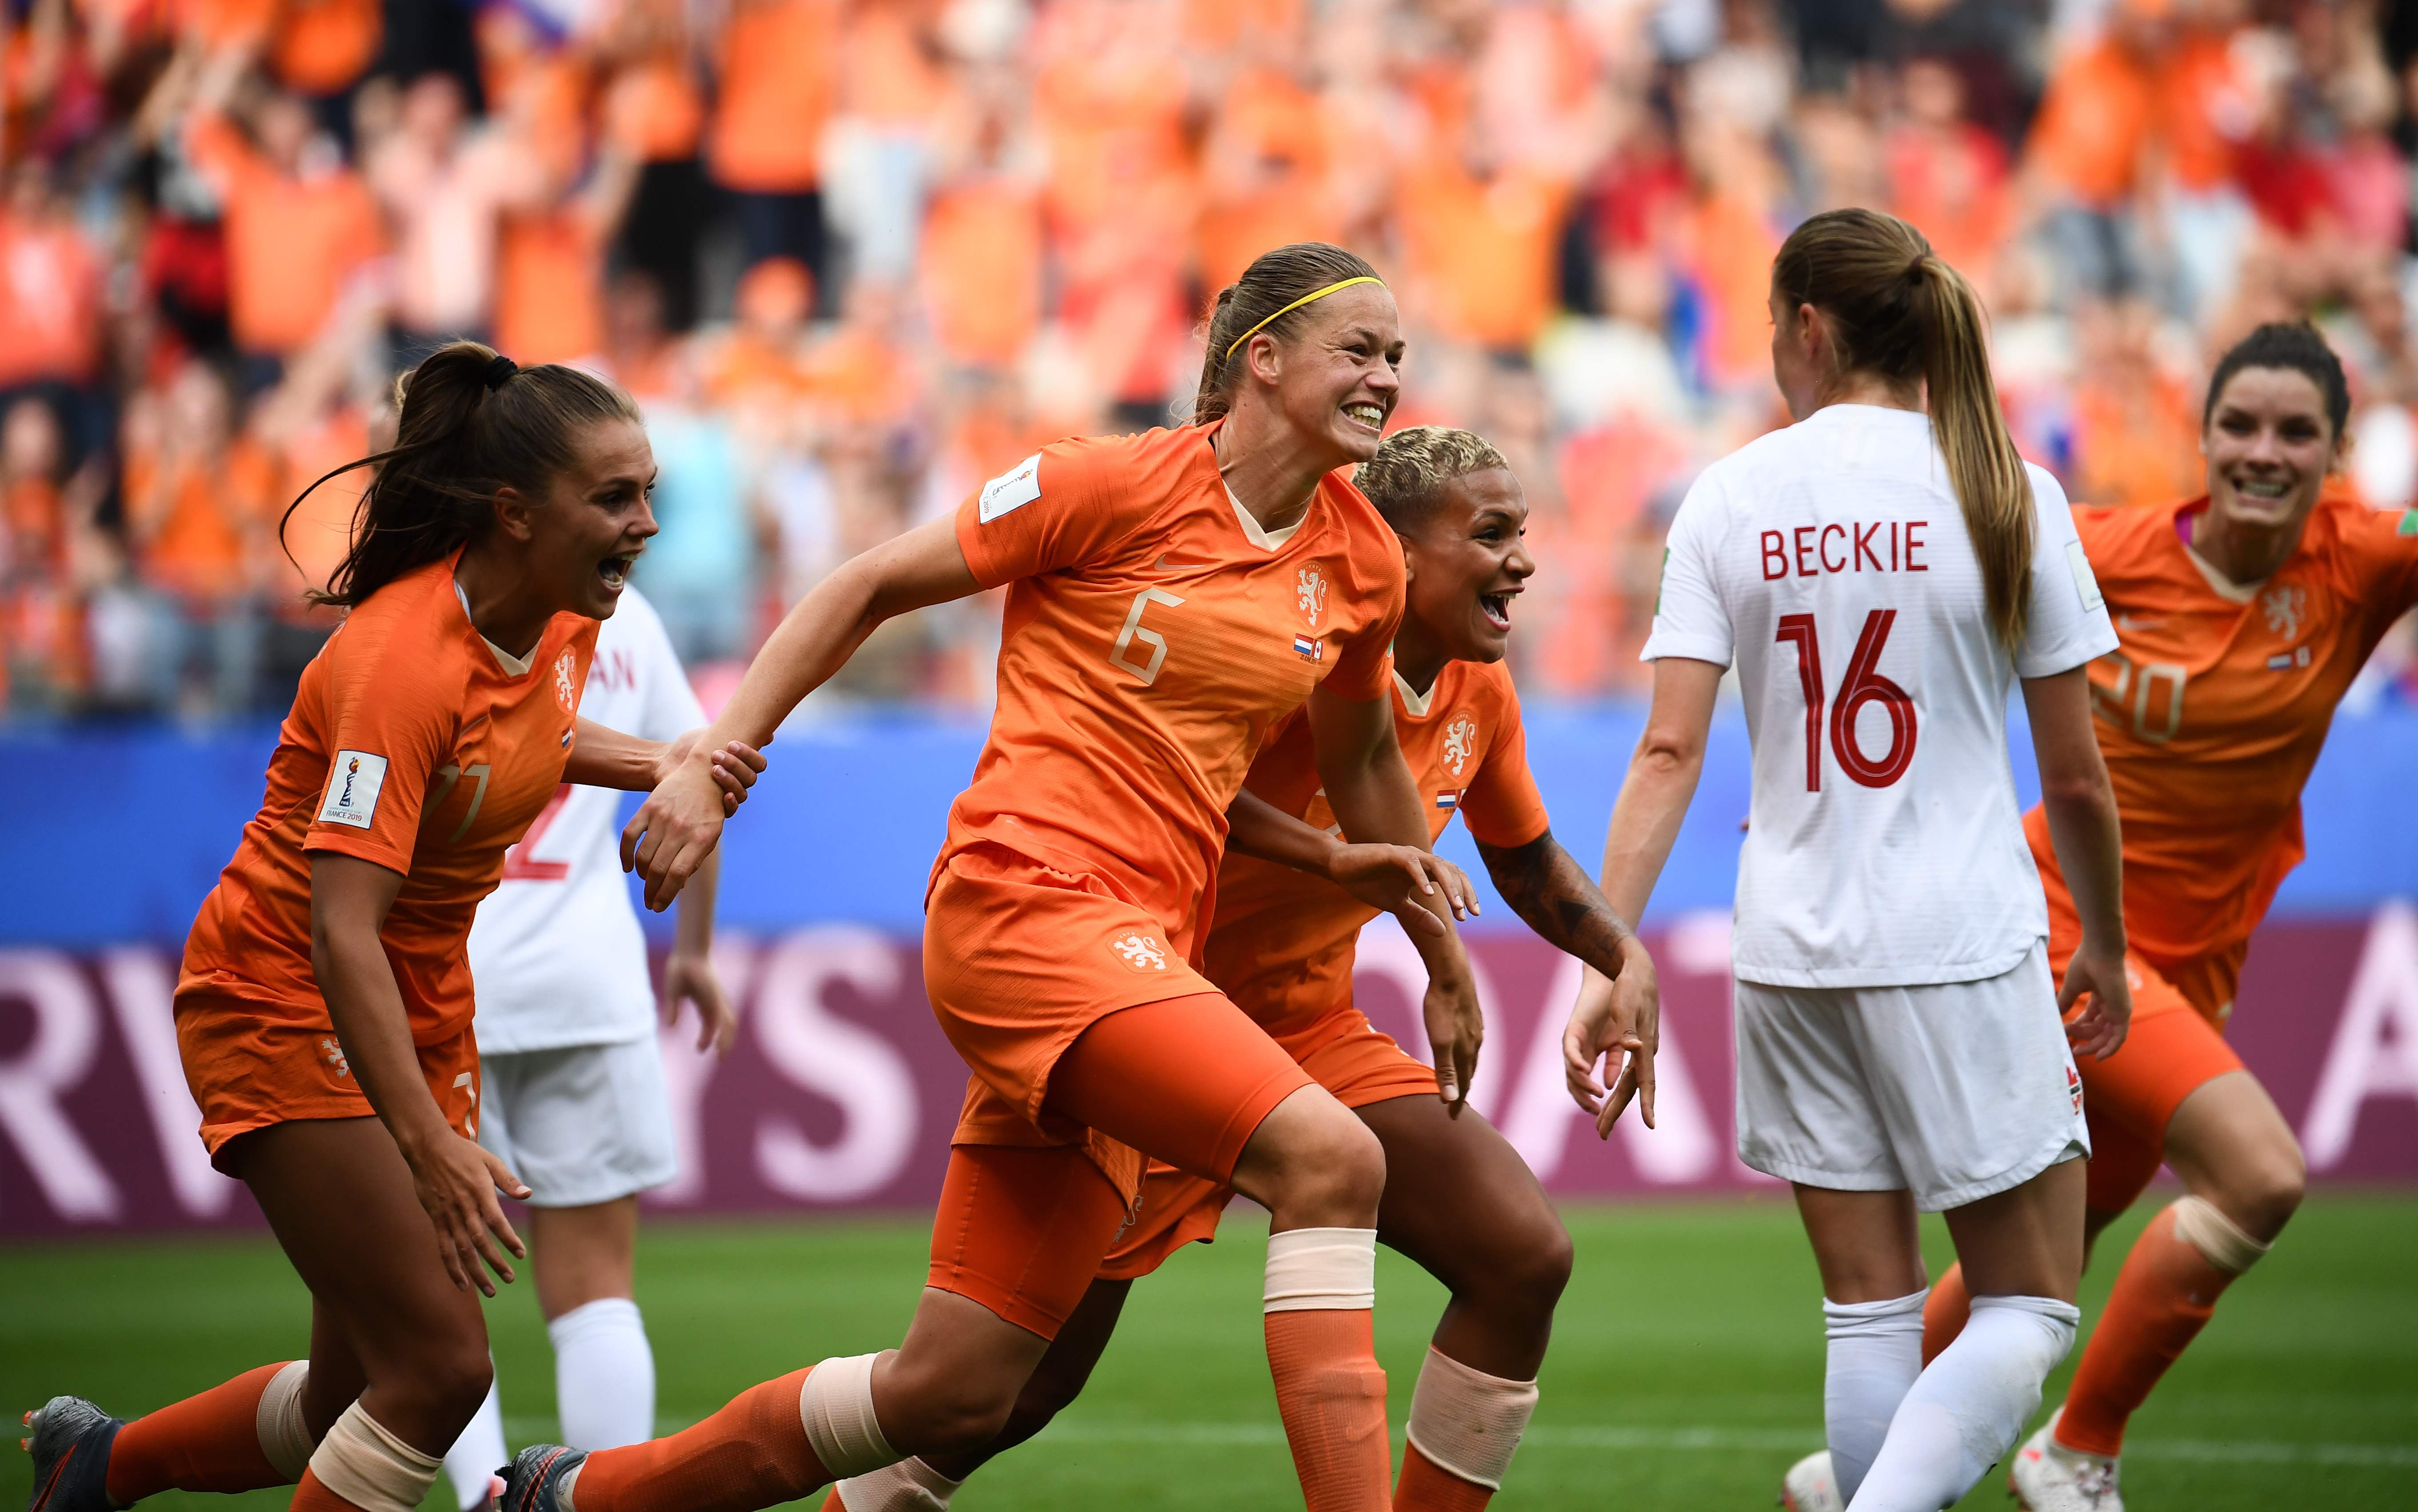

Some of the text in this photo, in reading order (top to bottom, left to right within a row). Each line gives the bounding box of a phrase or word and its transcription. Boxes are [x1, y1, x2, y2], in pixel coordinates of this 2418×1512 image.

[1761, 521, 1928, 581] BECKIE
[1108, 588, 1186, 686] 6
[1776, 609, 1917, 792] 16
[326, 810, 347, 818] FRANCE
[347, 813, 362, 822] 2019
